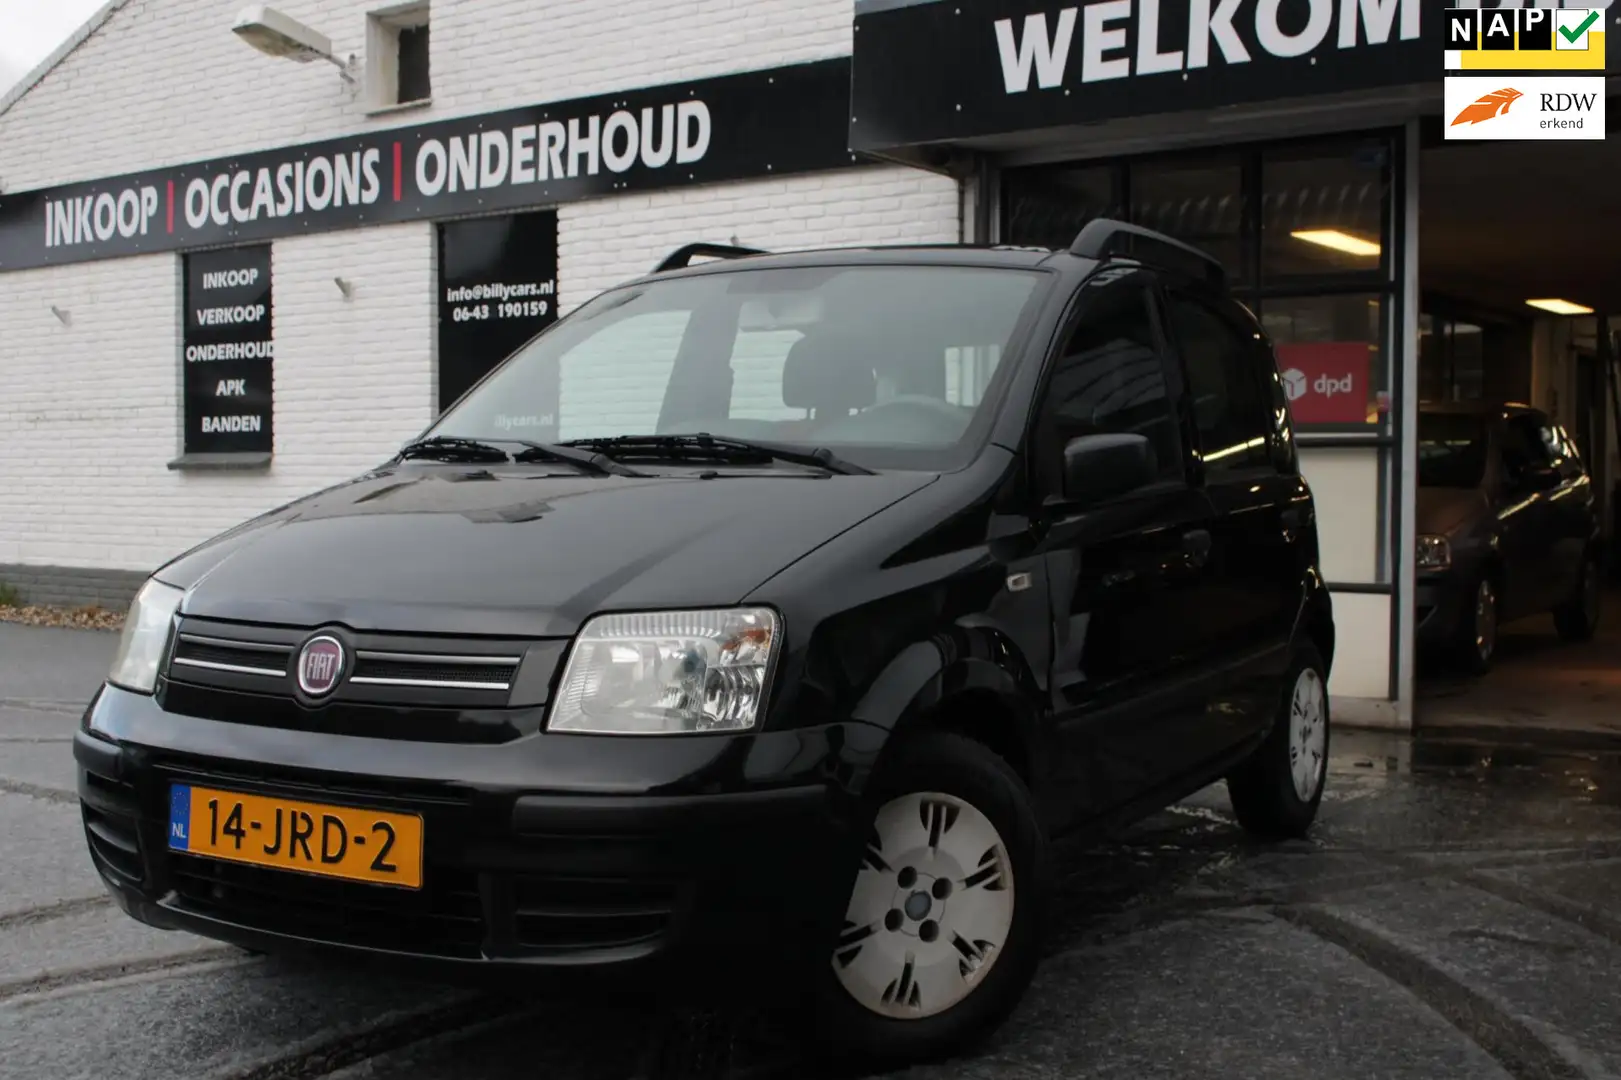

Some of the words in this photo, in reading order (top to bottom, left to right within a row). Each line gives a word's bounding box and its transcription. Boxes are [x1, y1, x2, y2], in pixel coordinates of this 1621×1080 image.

[994, 0, 1421, 94] WELKOM
[45, 185, 158, 247] INKOOP
[184, 147, 380, 229] OCCASIONS
[415, 100, 712, 196] ONDERHOUD
[203, 268, 259, 289] INKOOP
[447, 279, 554, 302] info@billycars.nl
[196, 304, 266, 326] VERKOOP
[453, 304, 490, 322] 06-43
[498, 301, 548, 318] 190159
[215, 379, 246, 397] APK
[1314, 372, 1353, 399] dpd
[202, 416, 261, 433] BANDEN
[306, 652, 335, 681] FIAT
[171, 822, 187, 839] NL
[208, 798, 397, 872] 14-JRD-2
